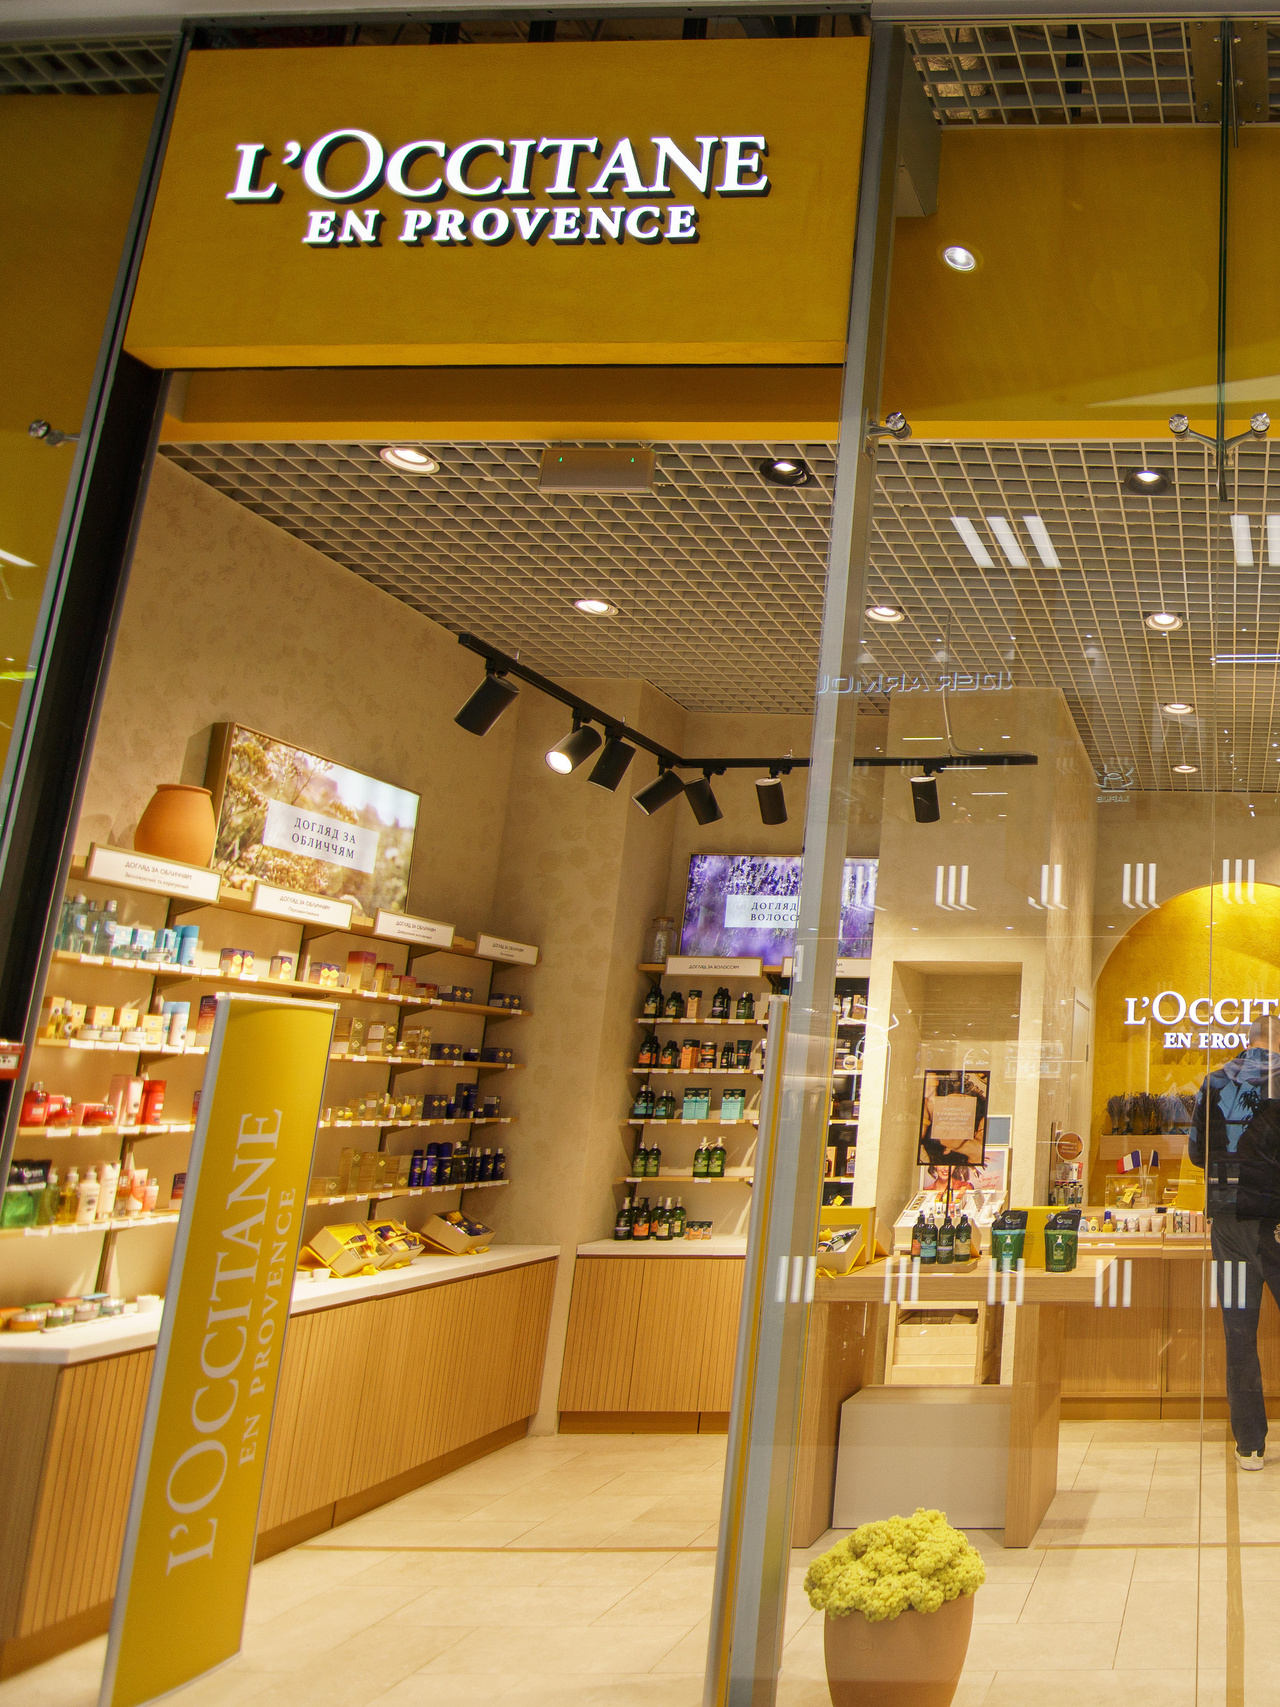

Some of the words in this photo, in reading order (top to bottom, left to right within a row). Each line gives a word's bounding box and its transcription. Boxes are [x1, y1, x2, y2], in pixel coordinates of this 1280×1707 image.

[301, 209, 381, 245] EN
[398, 205, 698, 243] PROVENCE
[293, 817, 340, 842] ДОГЛЯД
[342, 832, 357, 844] ЗА
[291, 832, 355, 859] ОБЛИЧЧЯМ
[125, 860, 151, 874] ДОГЛЯД
[151, 866, 160, 874] ЗА
[159, 867, 193, 882] ОБЛИЧЧЯМ
[750, 902, 797, 912] ДОГЛЯД
[1164, 1032, 1193, 1048] EN
[249, 1187, 296, 1397] PROVENCE
[239, 1414, 263, 1467] EN
